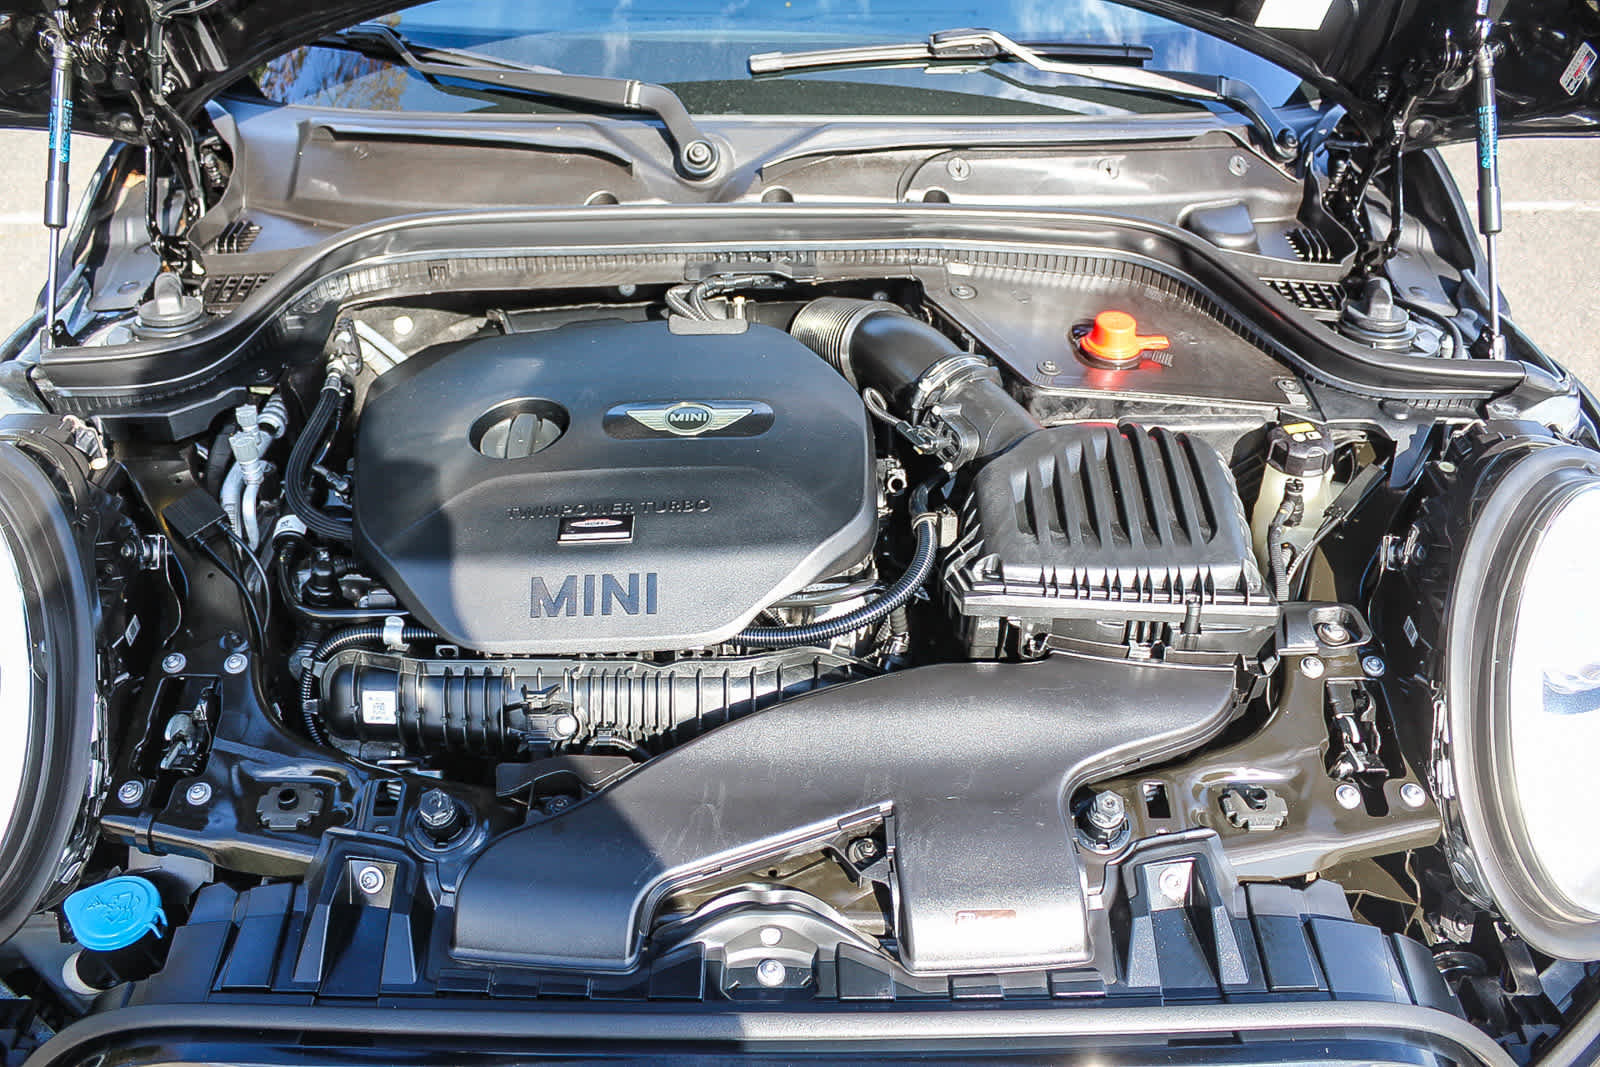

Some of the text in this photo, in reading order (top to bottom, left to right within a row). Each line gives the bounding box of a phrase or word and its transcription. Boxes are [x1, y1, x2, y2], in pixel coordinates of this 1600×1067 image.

[669, 413, 708, 422] MINI
[640, 498, 712, 514] TURBO
[530, 572, 657, 618] MINI
